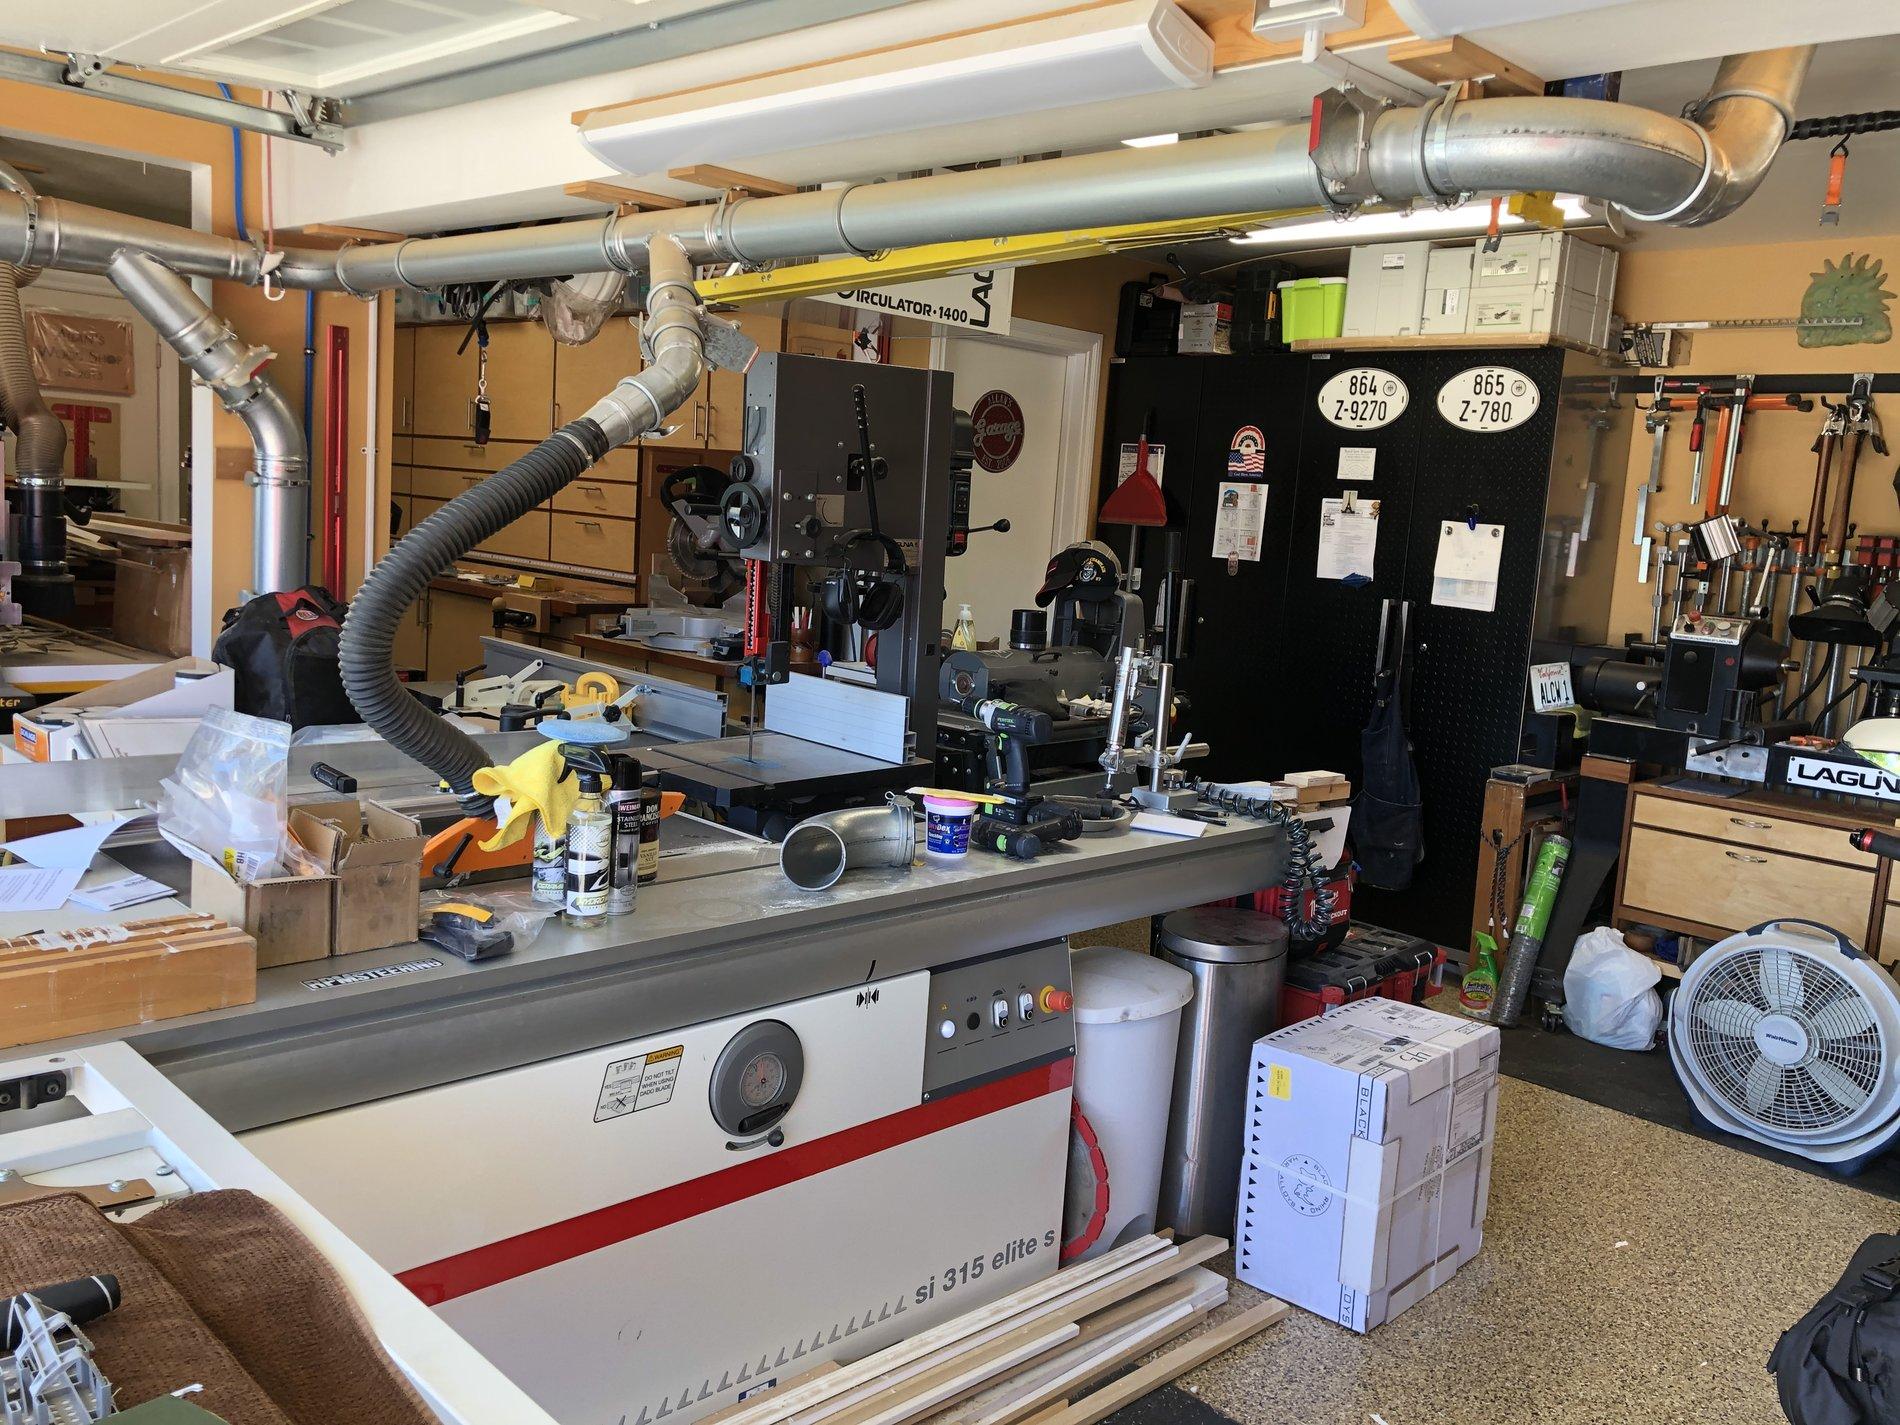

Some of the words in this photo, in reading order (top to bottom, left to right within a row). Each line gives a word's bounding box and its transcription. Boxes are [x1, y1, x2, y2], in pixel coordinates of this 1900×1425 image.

[1349, 375, 1377, 396] 864
[1473, 374, 1505, 396] 865
[1334, 400, 1387, 421] Z-9270
[1459, 400, 1512, 423] Z-780
[1798, 764, 1900, 794] LAGUN
[642, 1081, 657, 1089] WHEN
[658, 1076, 674, 1085] USING
[655, 1084, 672, 1093] BLADE
[1356, 1086, 1369, 1140] BLACK
[915, 1276, 935, 1305] si
[942, 1254, 985, 1292] 315
[991, 1237, 1038, 1271] elite
[1043, 1229, 1055, 1248] s
